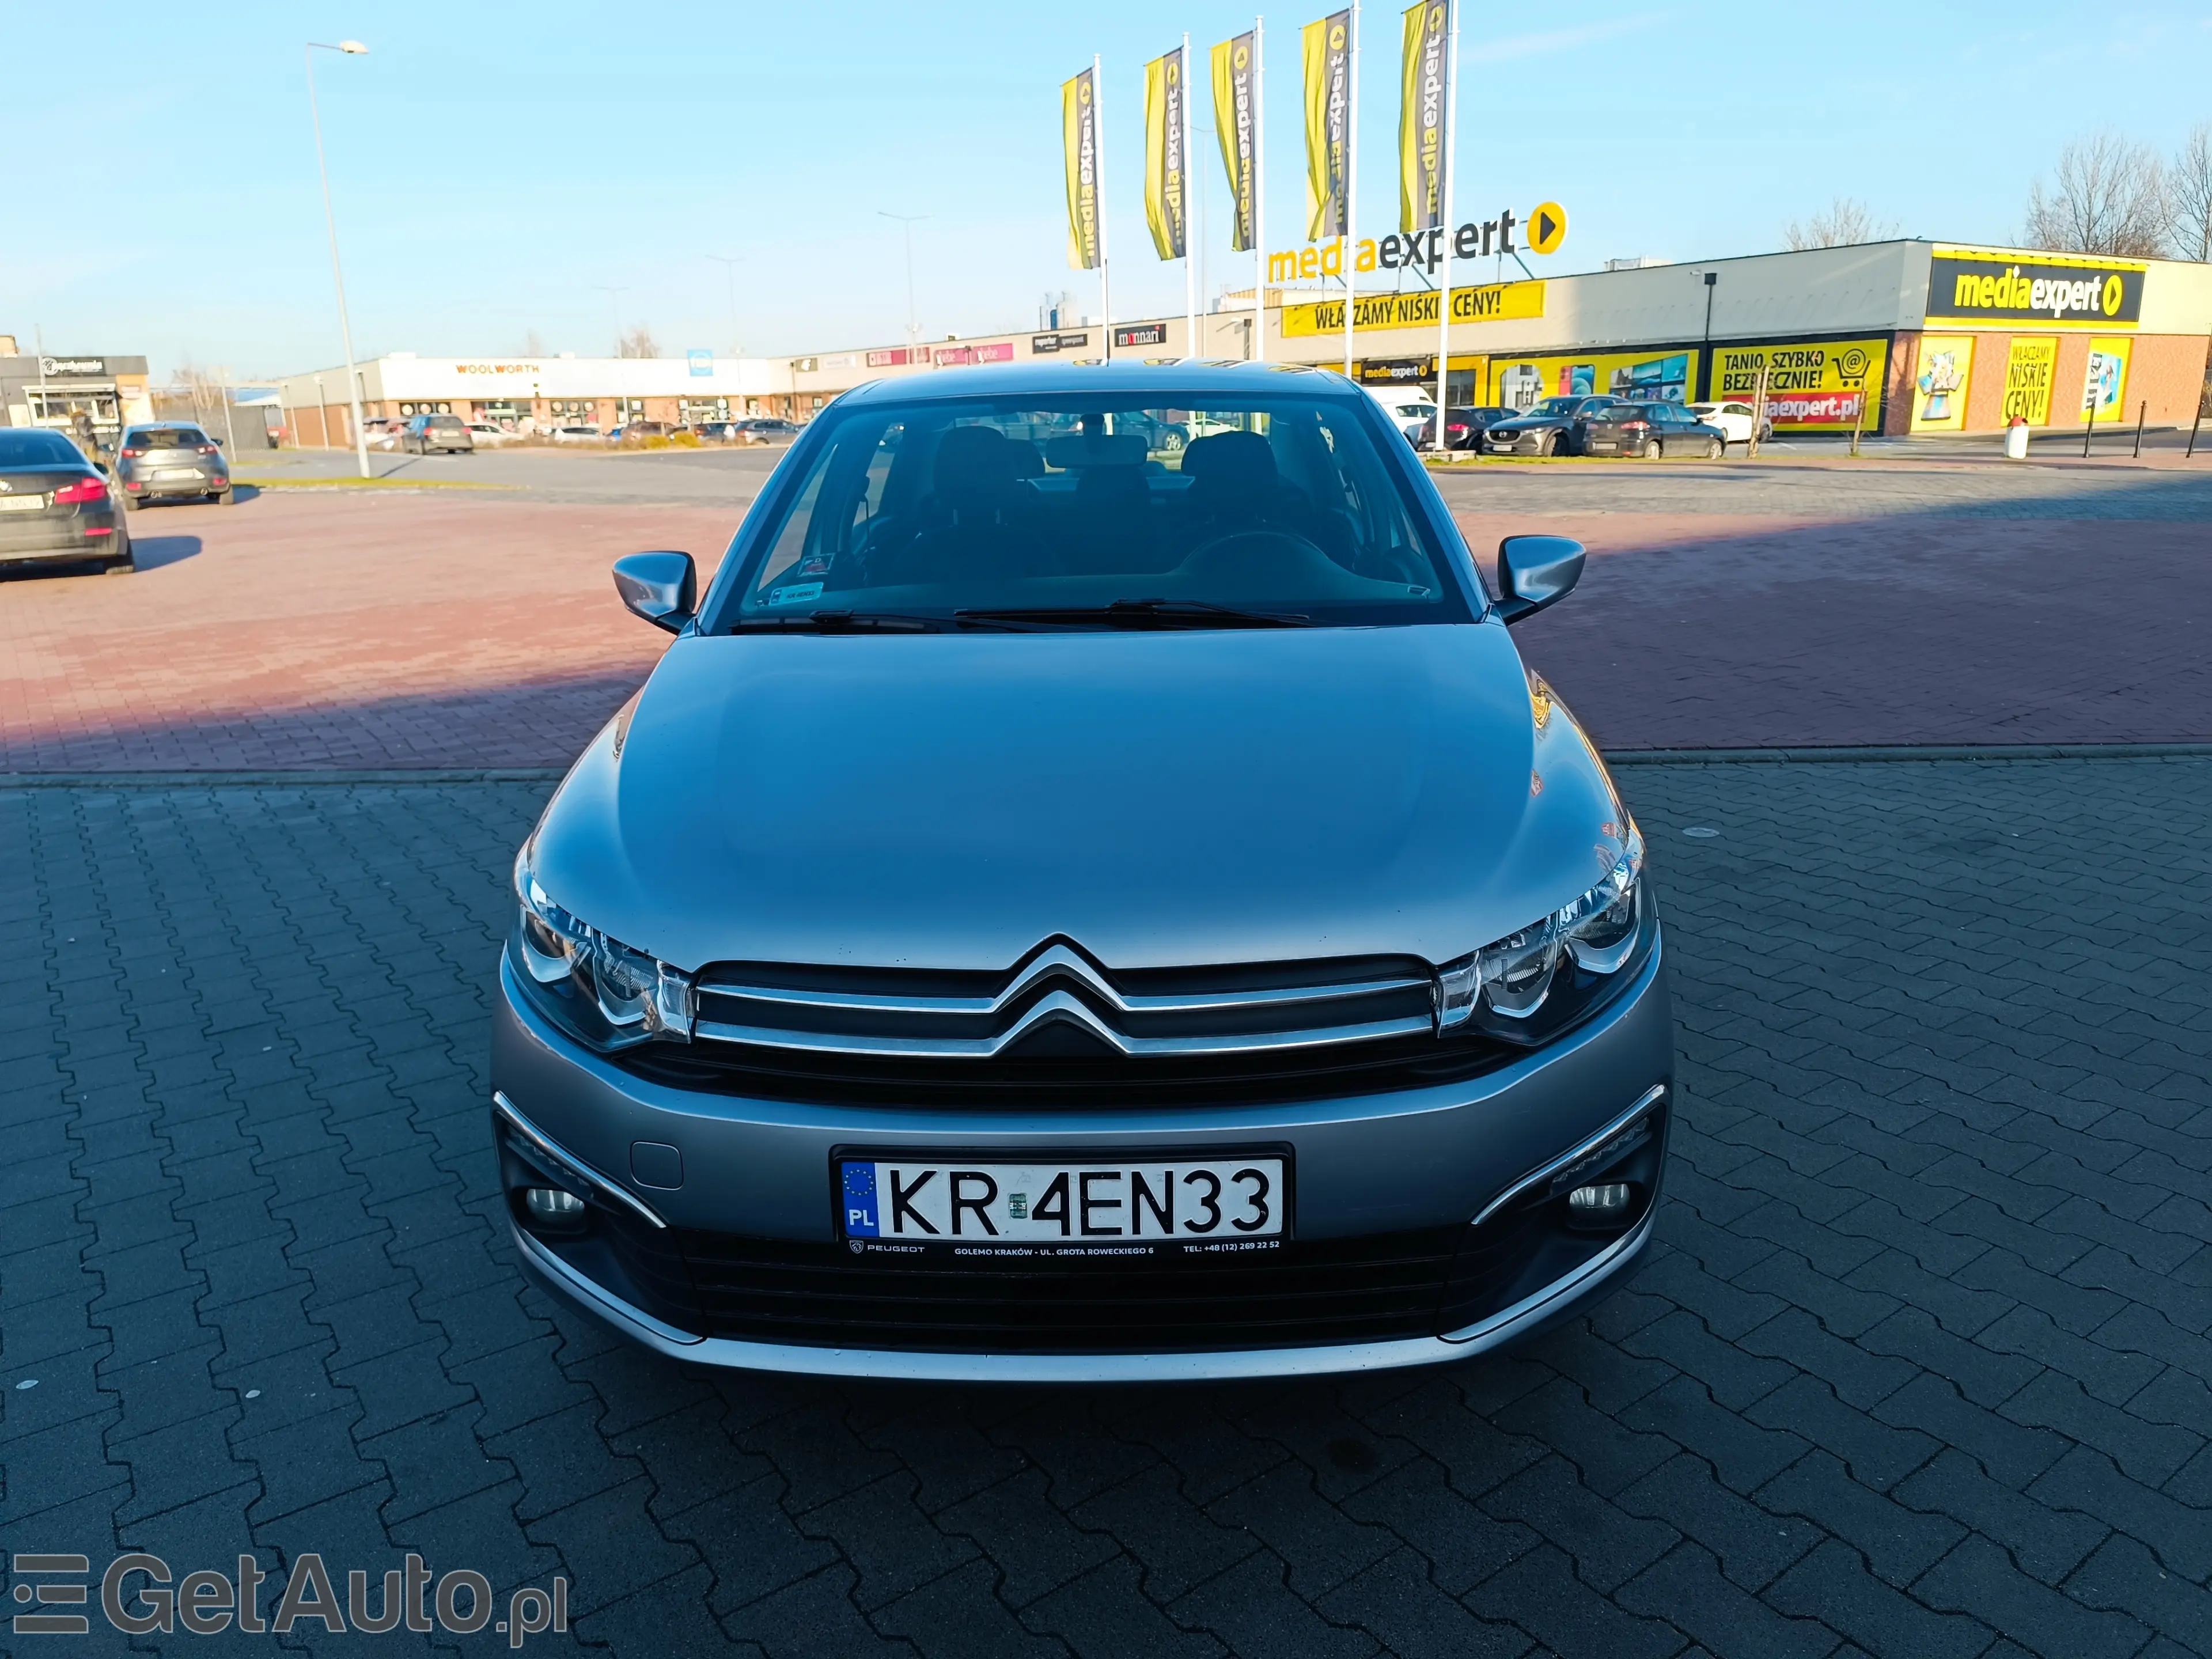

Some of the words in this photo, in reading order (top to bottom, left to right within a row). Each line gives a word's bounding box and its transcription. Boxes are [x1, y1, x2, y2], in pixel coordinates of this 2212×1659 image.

[1268, 209, 1516, 283] medaexpert
[1955, 265, 2102, 318] mediaexpert
[1398, 297, 1440, 322] NISKI
[1453, 291, 1501, 317] CENY!
[1119, 325, 1160, 346] monnari
[456, 364, 540, 374] WOOLWORTH
[1771, 350, 1824, 369] SZYBKO
[1365, 366, 1419, 378] mediaexpert
[2006, 389, 2044, 419] CENY!
[889, 1169, 999, 1236] KR
[1031, 1168, 1270, 1237] 4EN33
[849, 1209, 874, 1226] PL
[867, 1244, 925, 1253] PEUGEOT
[955, 1248, 993, 1256] GOLEMO
[995, 1247, 1033, 1256] KRAKÓW
[1183, 1245, 1202, 1253] TEL:
[1204, 1244, 1220, 1252] +48
[1221, 1243, 1238, 1252] (12)
[1240, 1242, 1255, 1251] 269
[1257, 1241, 1267, 1249] 22
[1269, 1240, 1280, 1249] 52
